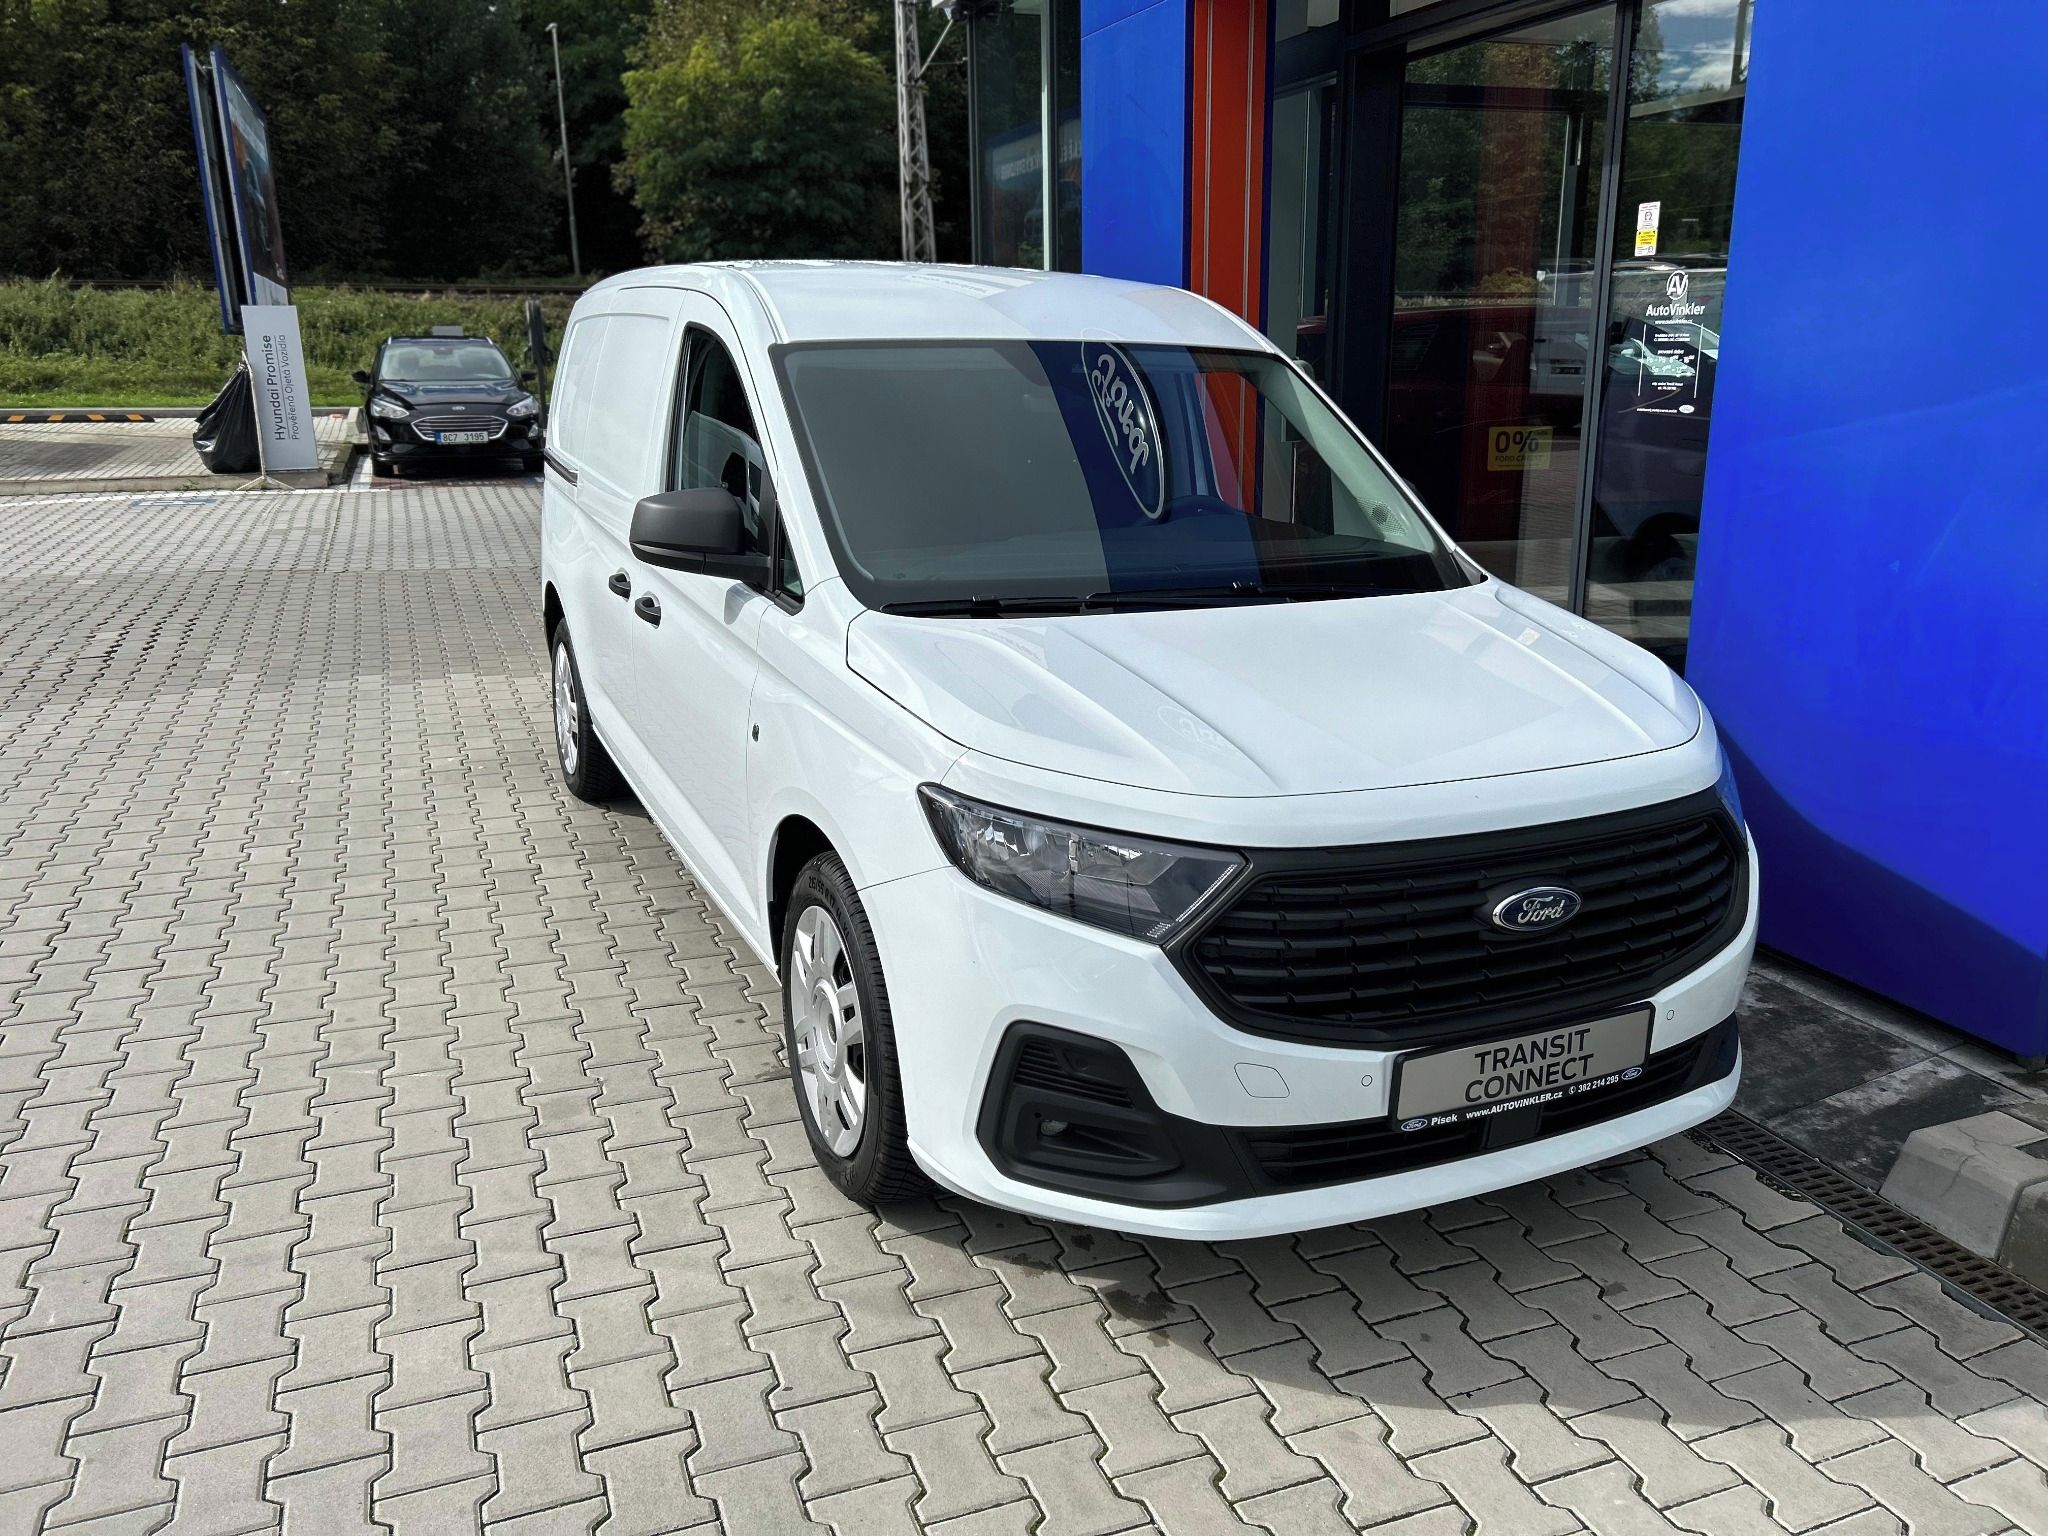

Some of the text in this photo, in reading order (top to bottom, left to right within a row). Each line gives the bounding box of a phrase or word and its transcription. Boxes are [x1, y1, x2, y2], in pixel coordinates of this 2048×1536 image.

[1646, 303, 1705, 317] AutoVinkler
[279, 334, 289, 368] Vozidlo
[262, 335, 287, 440] Hyundai Promise
[443, 433, 485, 442] 8C7 3195
[1496, 431, 1539, 453] 0%
[1518, 896, 1565, 924] Ford
[1474, 1028, 1591, 1075] TRANSIT
[1465, 1053, 1594, 1102] CONNECT
[1466, 1092, 1563, 1119] www.AUTOVINKLER.cz
[1578, 1083, 1591, 1093] 382
[1592, 1078, 1605, 1089] 214
[1606, 1075, 1619, 1085] 295
